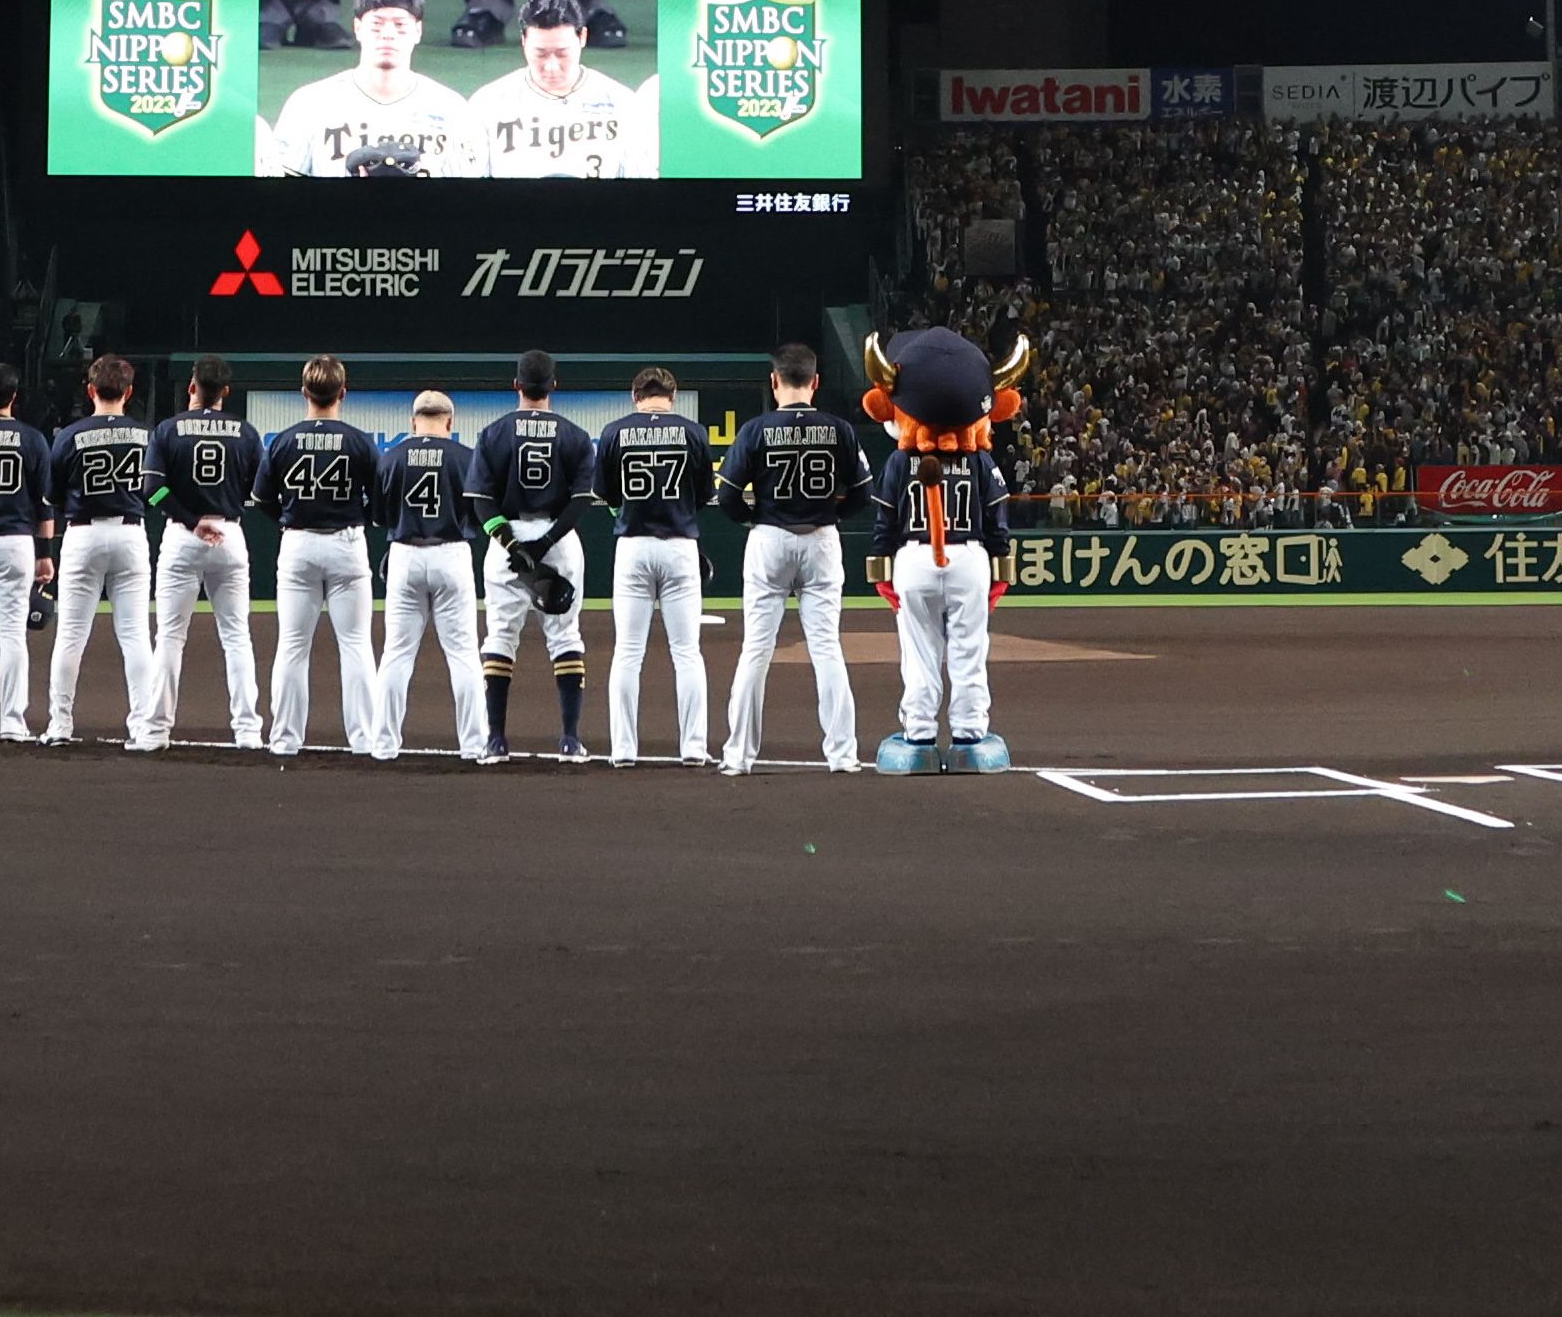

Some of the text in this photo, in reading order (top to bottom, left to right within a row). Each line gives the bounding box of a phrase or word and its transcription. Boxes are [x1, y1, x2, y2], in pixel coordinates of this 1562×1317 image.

[108, 1, 202, 29] SMBC
[714, 6, 805, 34] SMBC
[103, 65, 204, 93] SERIES
[710, 70, 809, 98] SERIES
[1163, 73, 1223, 103] 水素
[130, 95, 176, 113] 2023
[738, 99, 782, 117] 2023
[951, 75, 1142, 116] Iwatani
[497, 117, 618, 158] Tigers
[736, 193, 850, 212] 三井住友銀行
[292, 248, 439, 272] MITSUBISHI
[461, 248, 704, 297] オーロラビジョン
[292, 273, 420, 297] ELECTRIC
[176, 419, 242, 438] GONZALEZ
[763, 425, 838, 446] NAKAJIMA
[82, 448, 144, 496] 24
[192, 440, 226, 486] 8
[407, 448, 443, 467] MORI
[518, 442, 552, 489] 6
[284, 454, 350, 500] 44
[621, 450, 688, 500] 67
[766, 450, 835, 499] 78
[1440, 470, 1555, 508] Coca-Cola
[404, 471, 441, 518] 4
